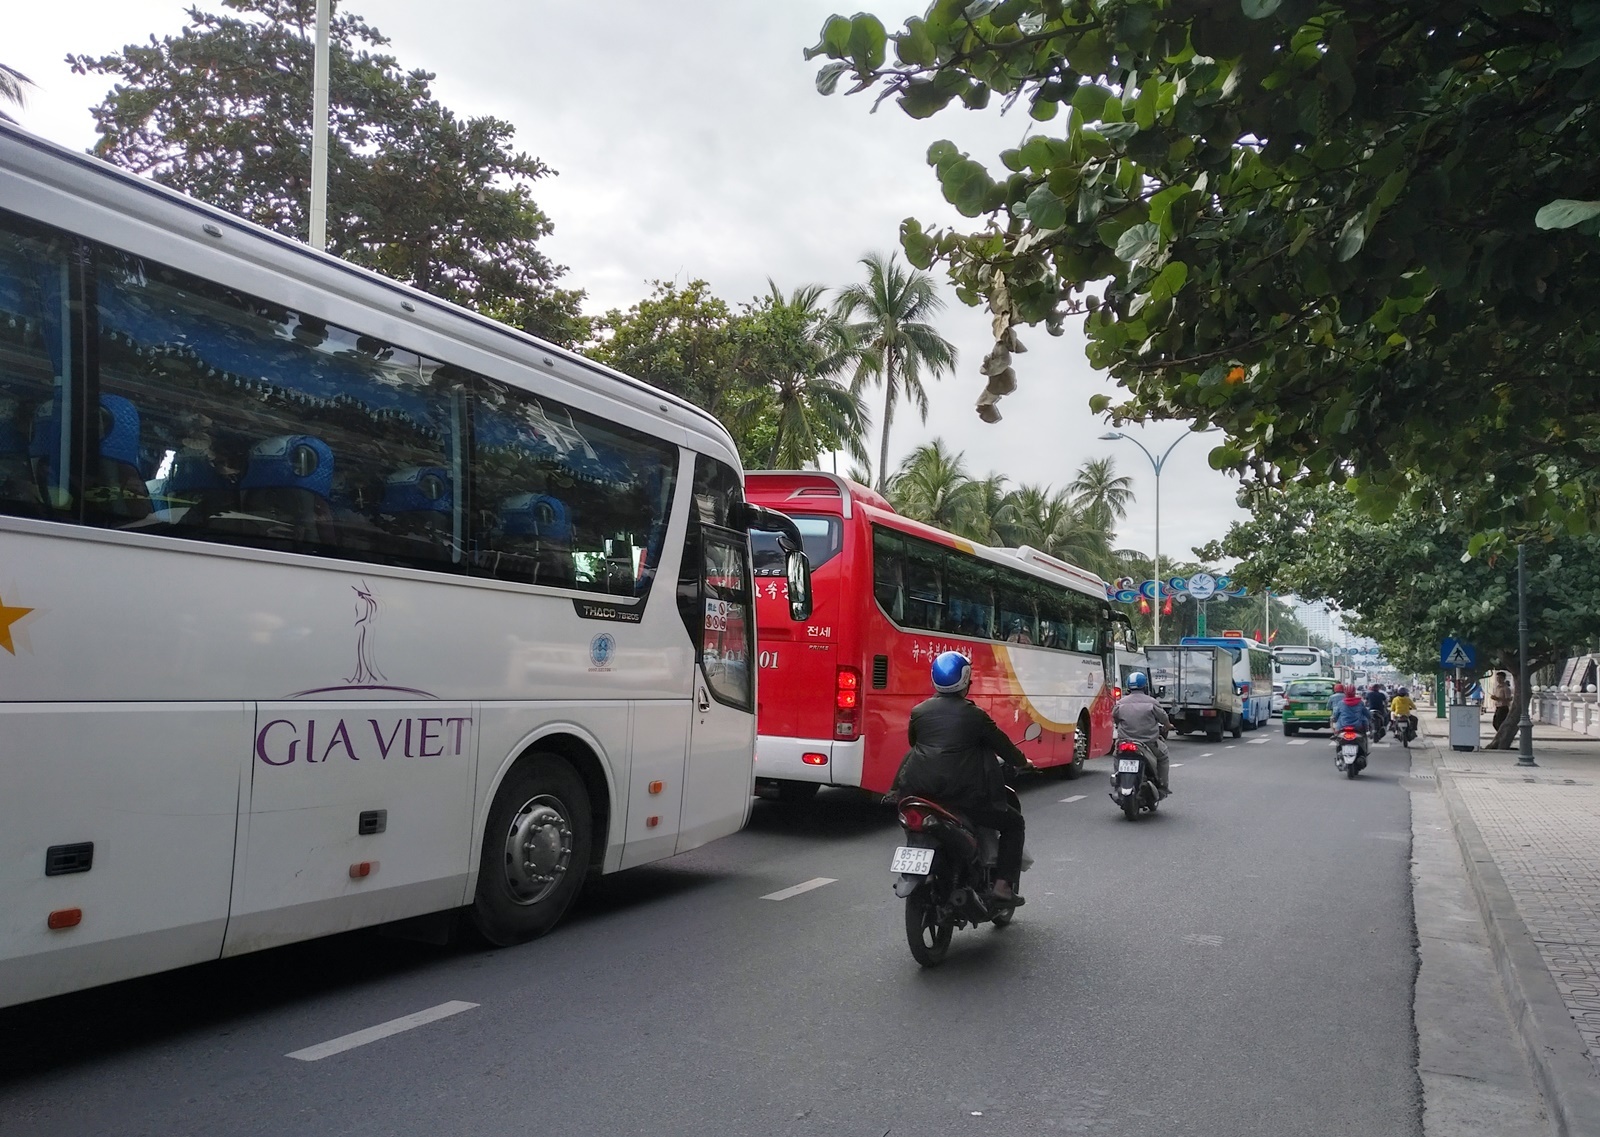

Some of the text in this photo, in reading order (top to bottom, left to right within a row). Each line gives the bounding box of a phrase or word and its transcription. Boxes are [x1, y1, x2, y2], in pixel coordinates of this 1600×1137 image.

[583, 605, 616, 618] THACO
[807, 625, 831, 638] 전세
[759, 650, 779, 669] 01
[256, 717, 473, 766] GIA VIET
[900, 849, 928, 861] 85-F1
[893, 860, 929, 873] 257.85
